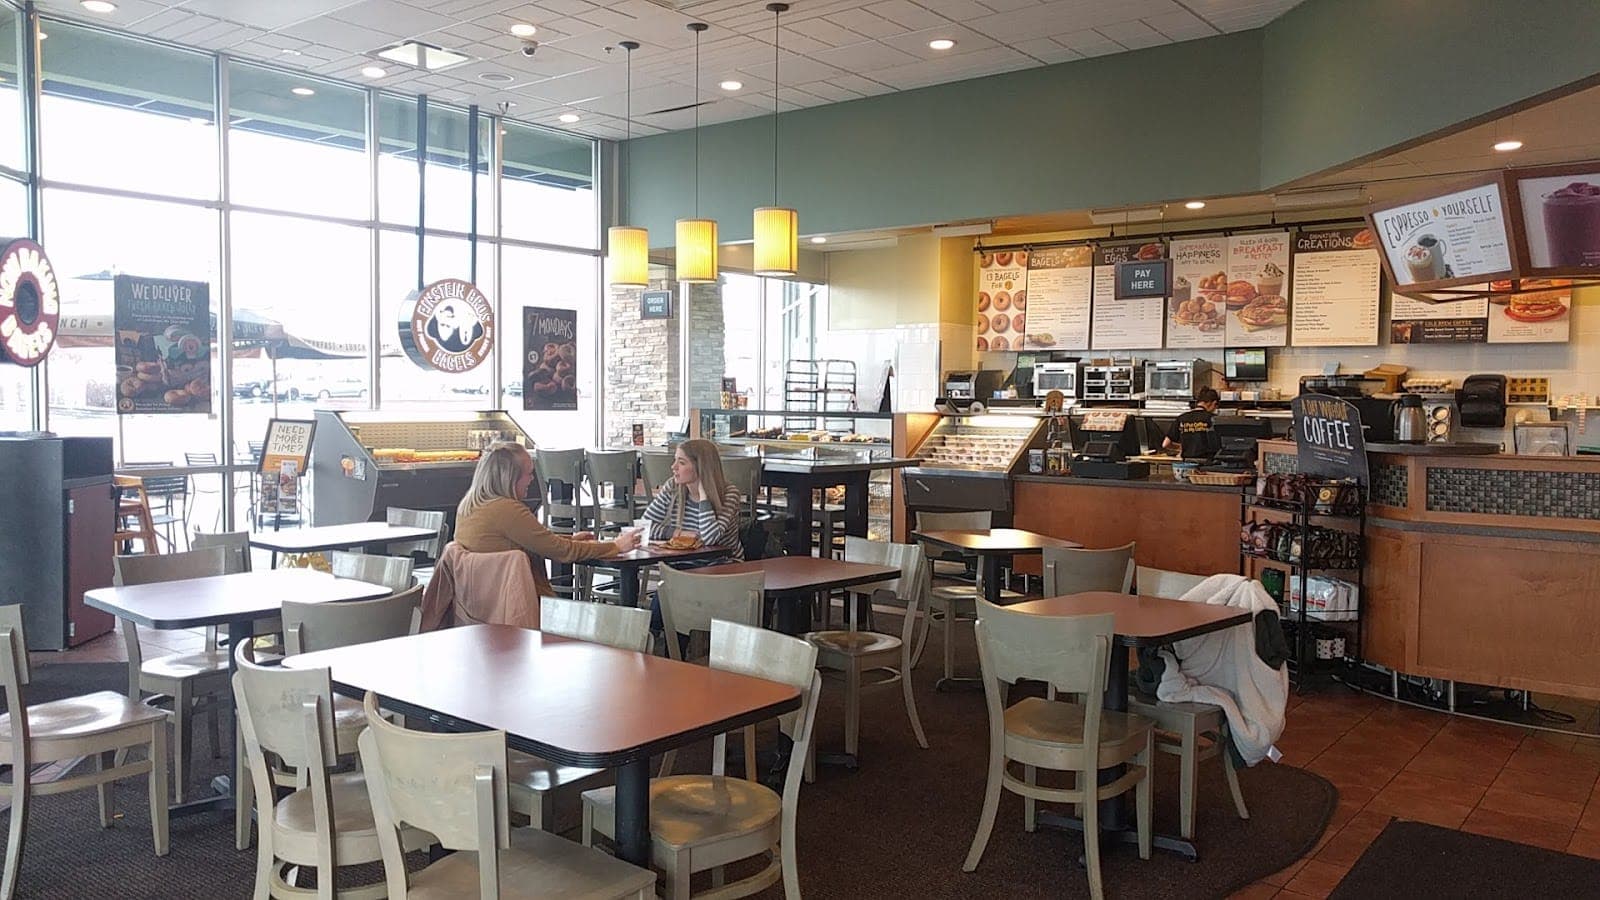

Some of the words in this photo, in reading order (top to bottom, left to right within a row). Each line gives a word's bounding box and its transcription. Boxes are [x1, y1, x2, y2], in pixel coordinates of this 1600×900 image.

[1383, 210, 1429, 249] ESPRESSO
[1441, 194, 1493, 216] YOURSELF
[1297, 237, 1353, 249] CREATIONS
[1176, 249, 1221, 260] HAPPINESS
[1233, 243, 1284, 255] BREAKFAST
[1031, 256, 1060, 267] BAGELS
[1104, 253, 1128, 264] EGGS
[994, 272, 1020, 281] BAGELS
[1134, 269, 1151, 278] PAY
[1131, 280, 1155, 290] HERE
[131, 283, 150, 300] WE
[152, 284, 192, 303] DELIVER
[60, 317, 89, 329] NCH
[538, 317, 573, 340] MONDAYS
[278, 424, 305, 435] NEED
[1303, 415, 1354, 450] COFFEE
[275, 433, 305, 444] MORE
[272, 442, 304, 453] TIME?
